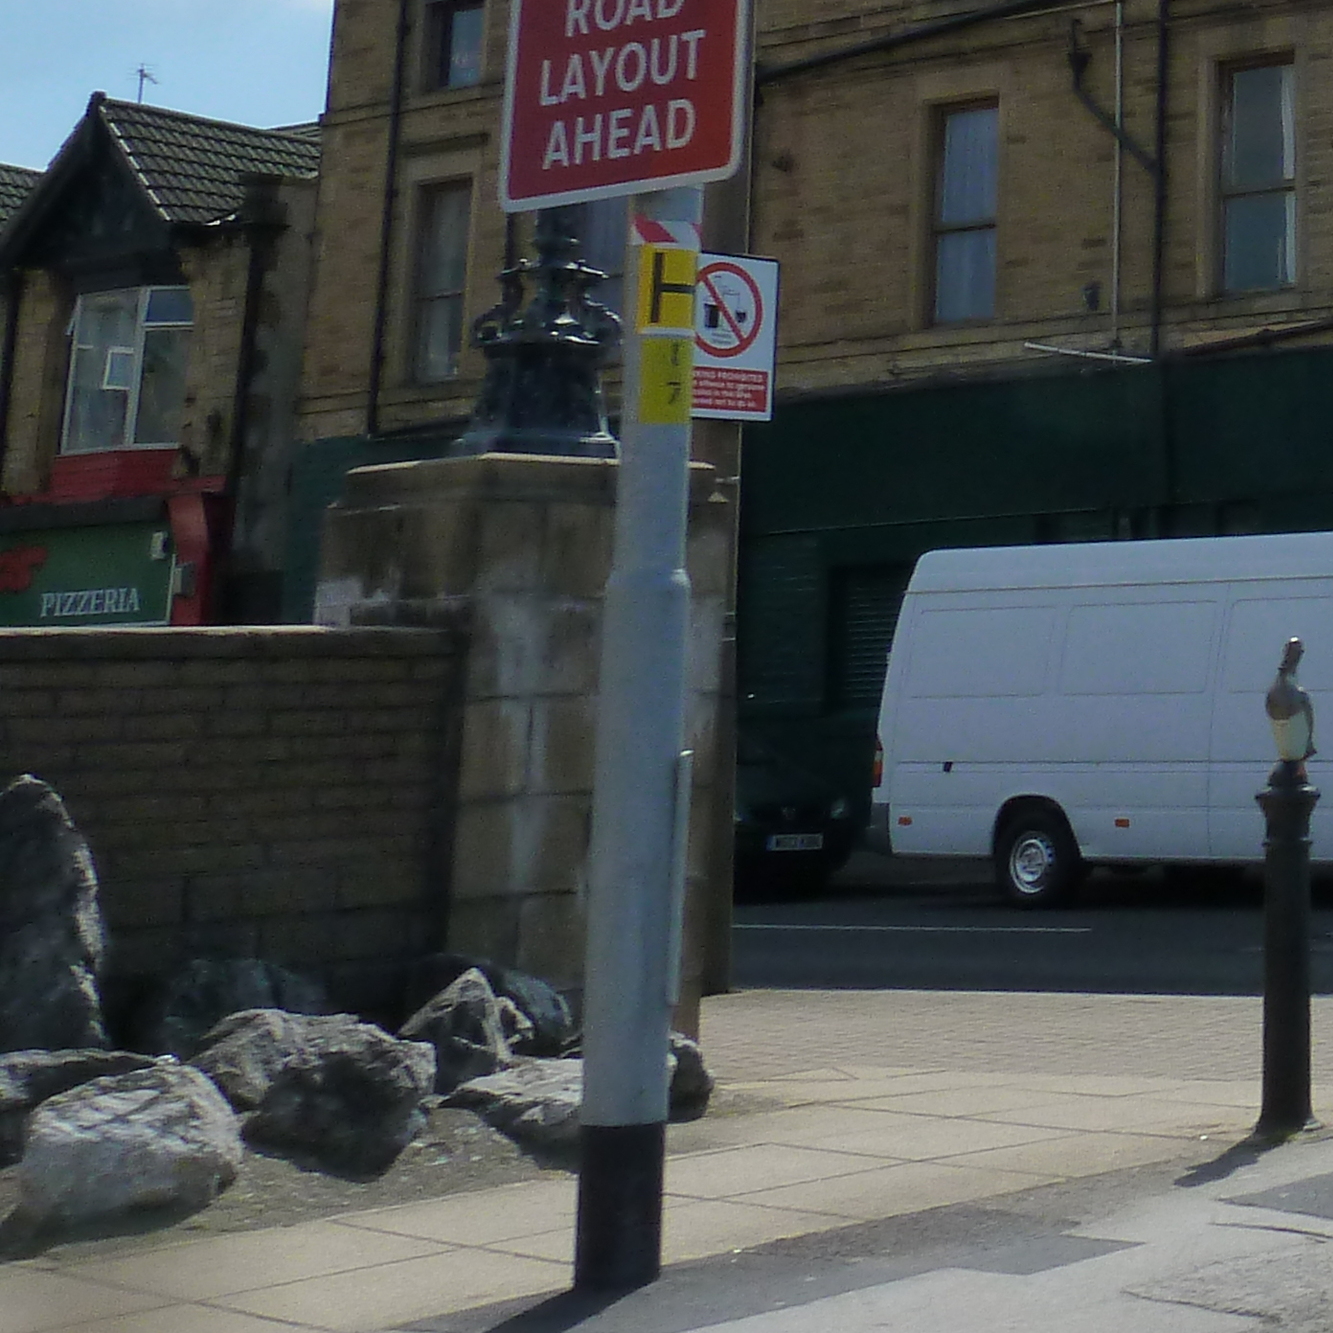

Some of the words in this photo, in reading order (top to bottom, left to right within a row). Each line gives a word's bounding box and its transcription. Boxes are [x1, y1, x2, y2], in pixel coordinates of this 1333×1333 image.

[539, 29, 706, 106] LAYOUT
[542, 98, 696, 170] AHEAD
[651, 252, 696, 324] H
[41, 588, 140, 617] PIZZERIA
